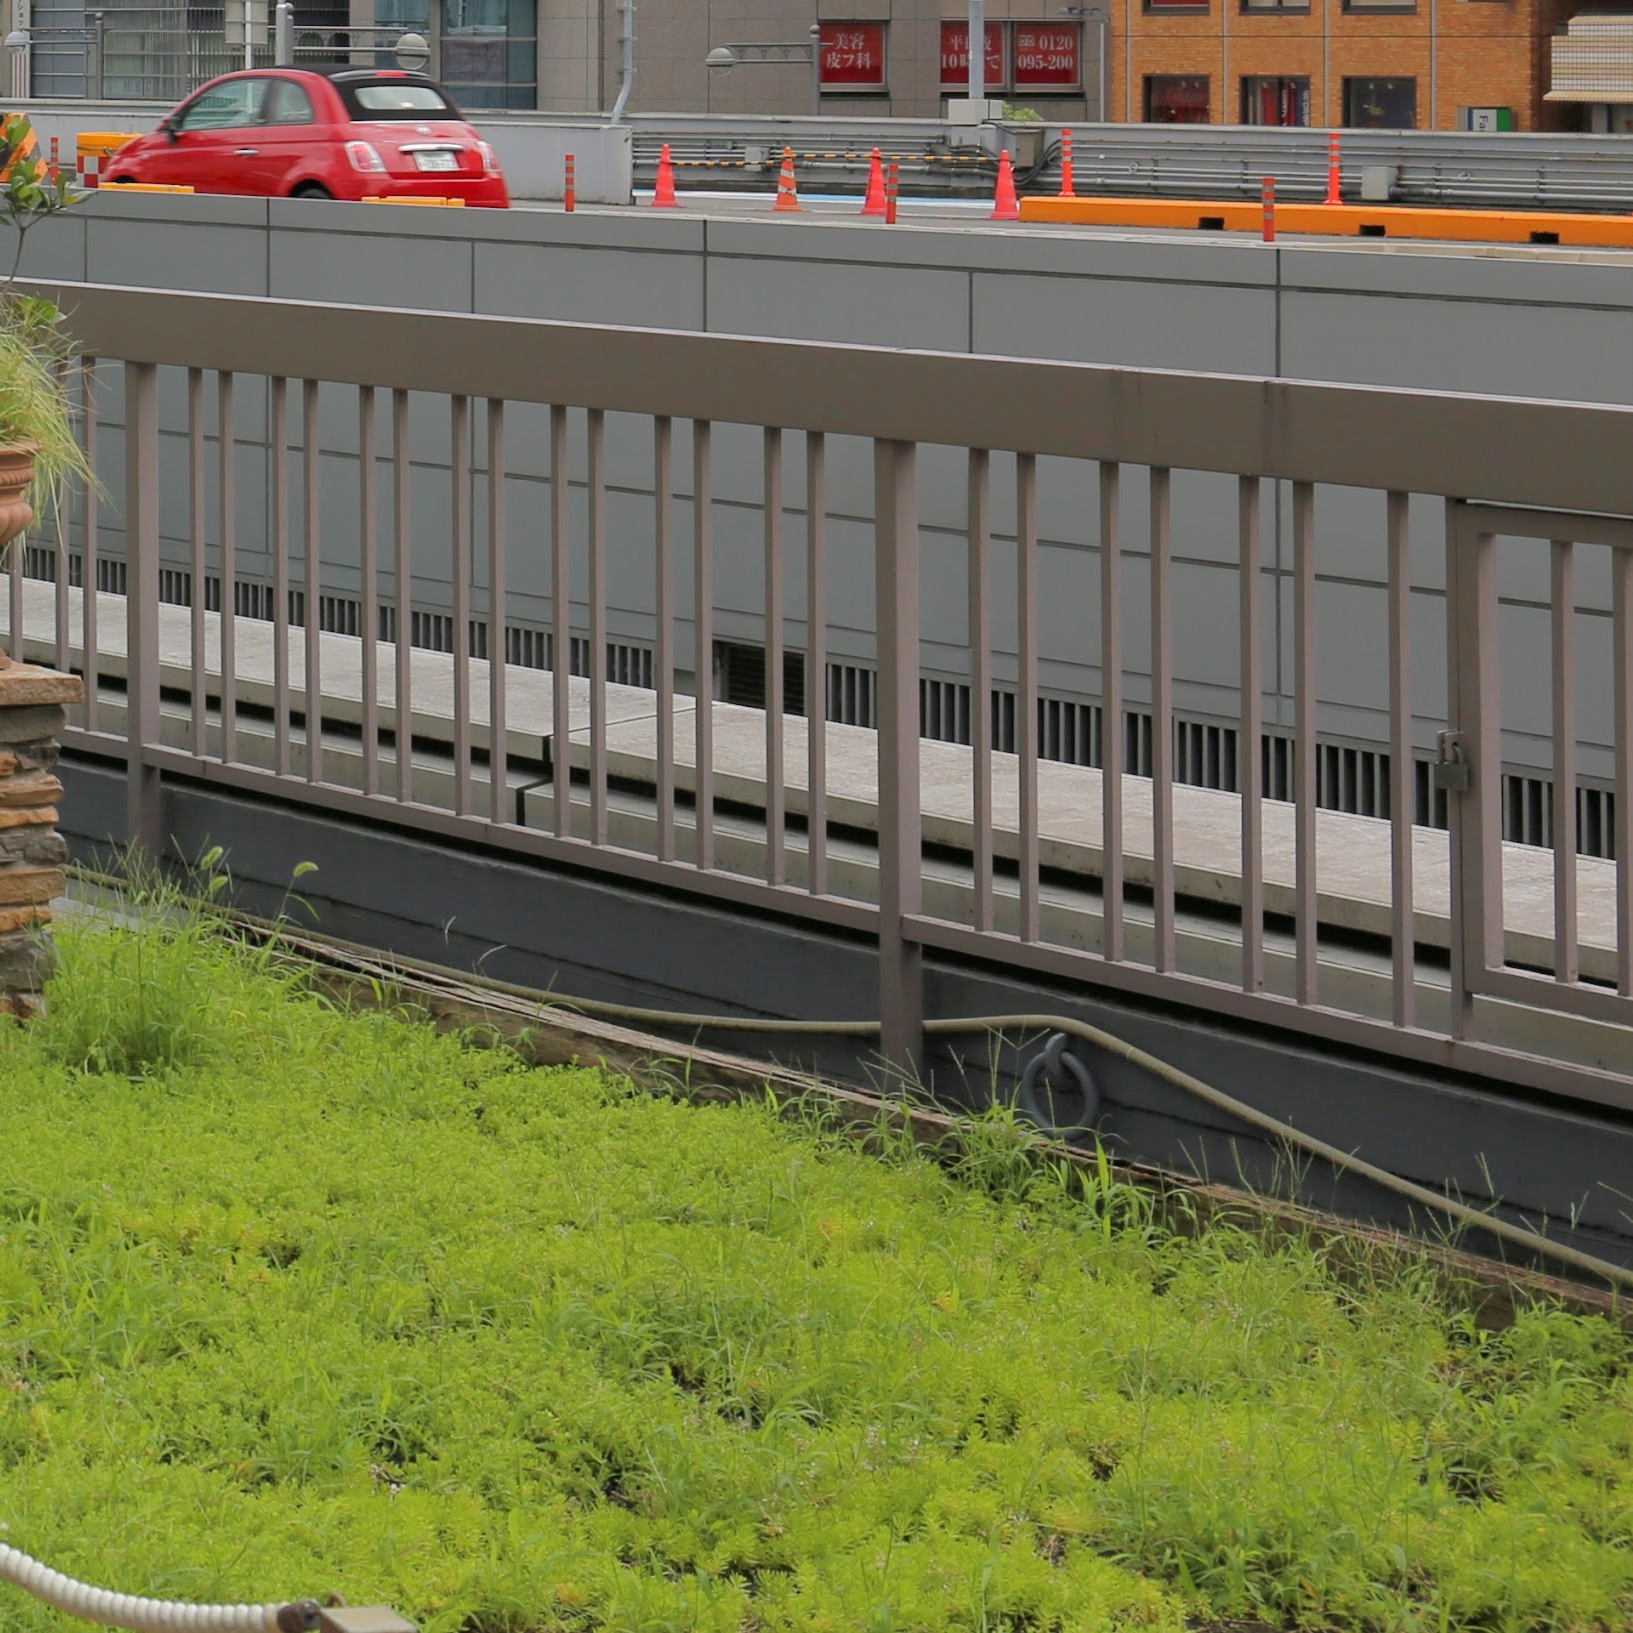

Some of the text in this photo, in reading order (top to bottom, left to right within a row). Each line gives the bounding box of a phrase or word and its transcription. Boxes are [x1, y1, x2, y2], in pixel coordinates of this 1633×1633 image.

[834, 32, 865, 50] 美容
[950, 34, 992, 51] 平夜
[1039, 36, 1073, 51] 0120
[826, 51, 872, 70] 皮フ科
[1018, 54, 1073, 71] 095-200
